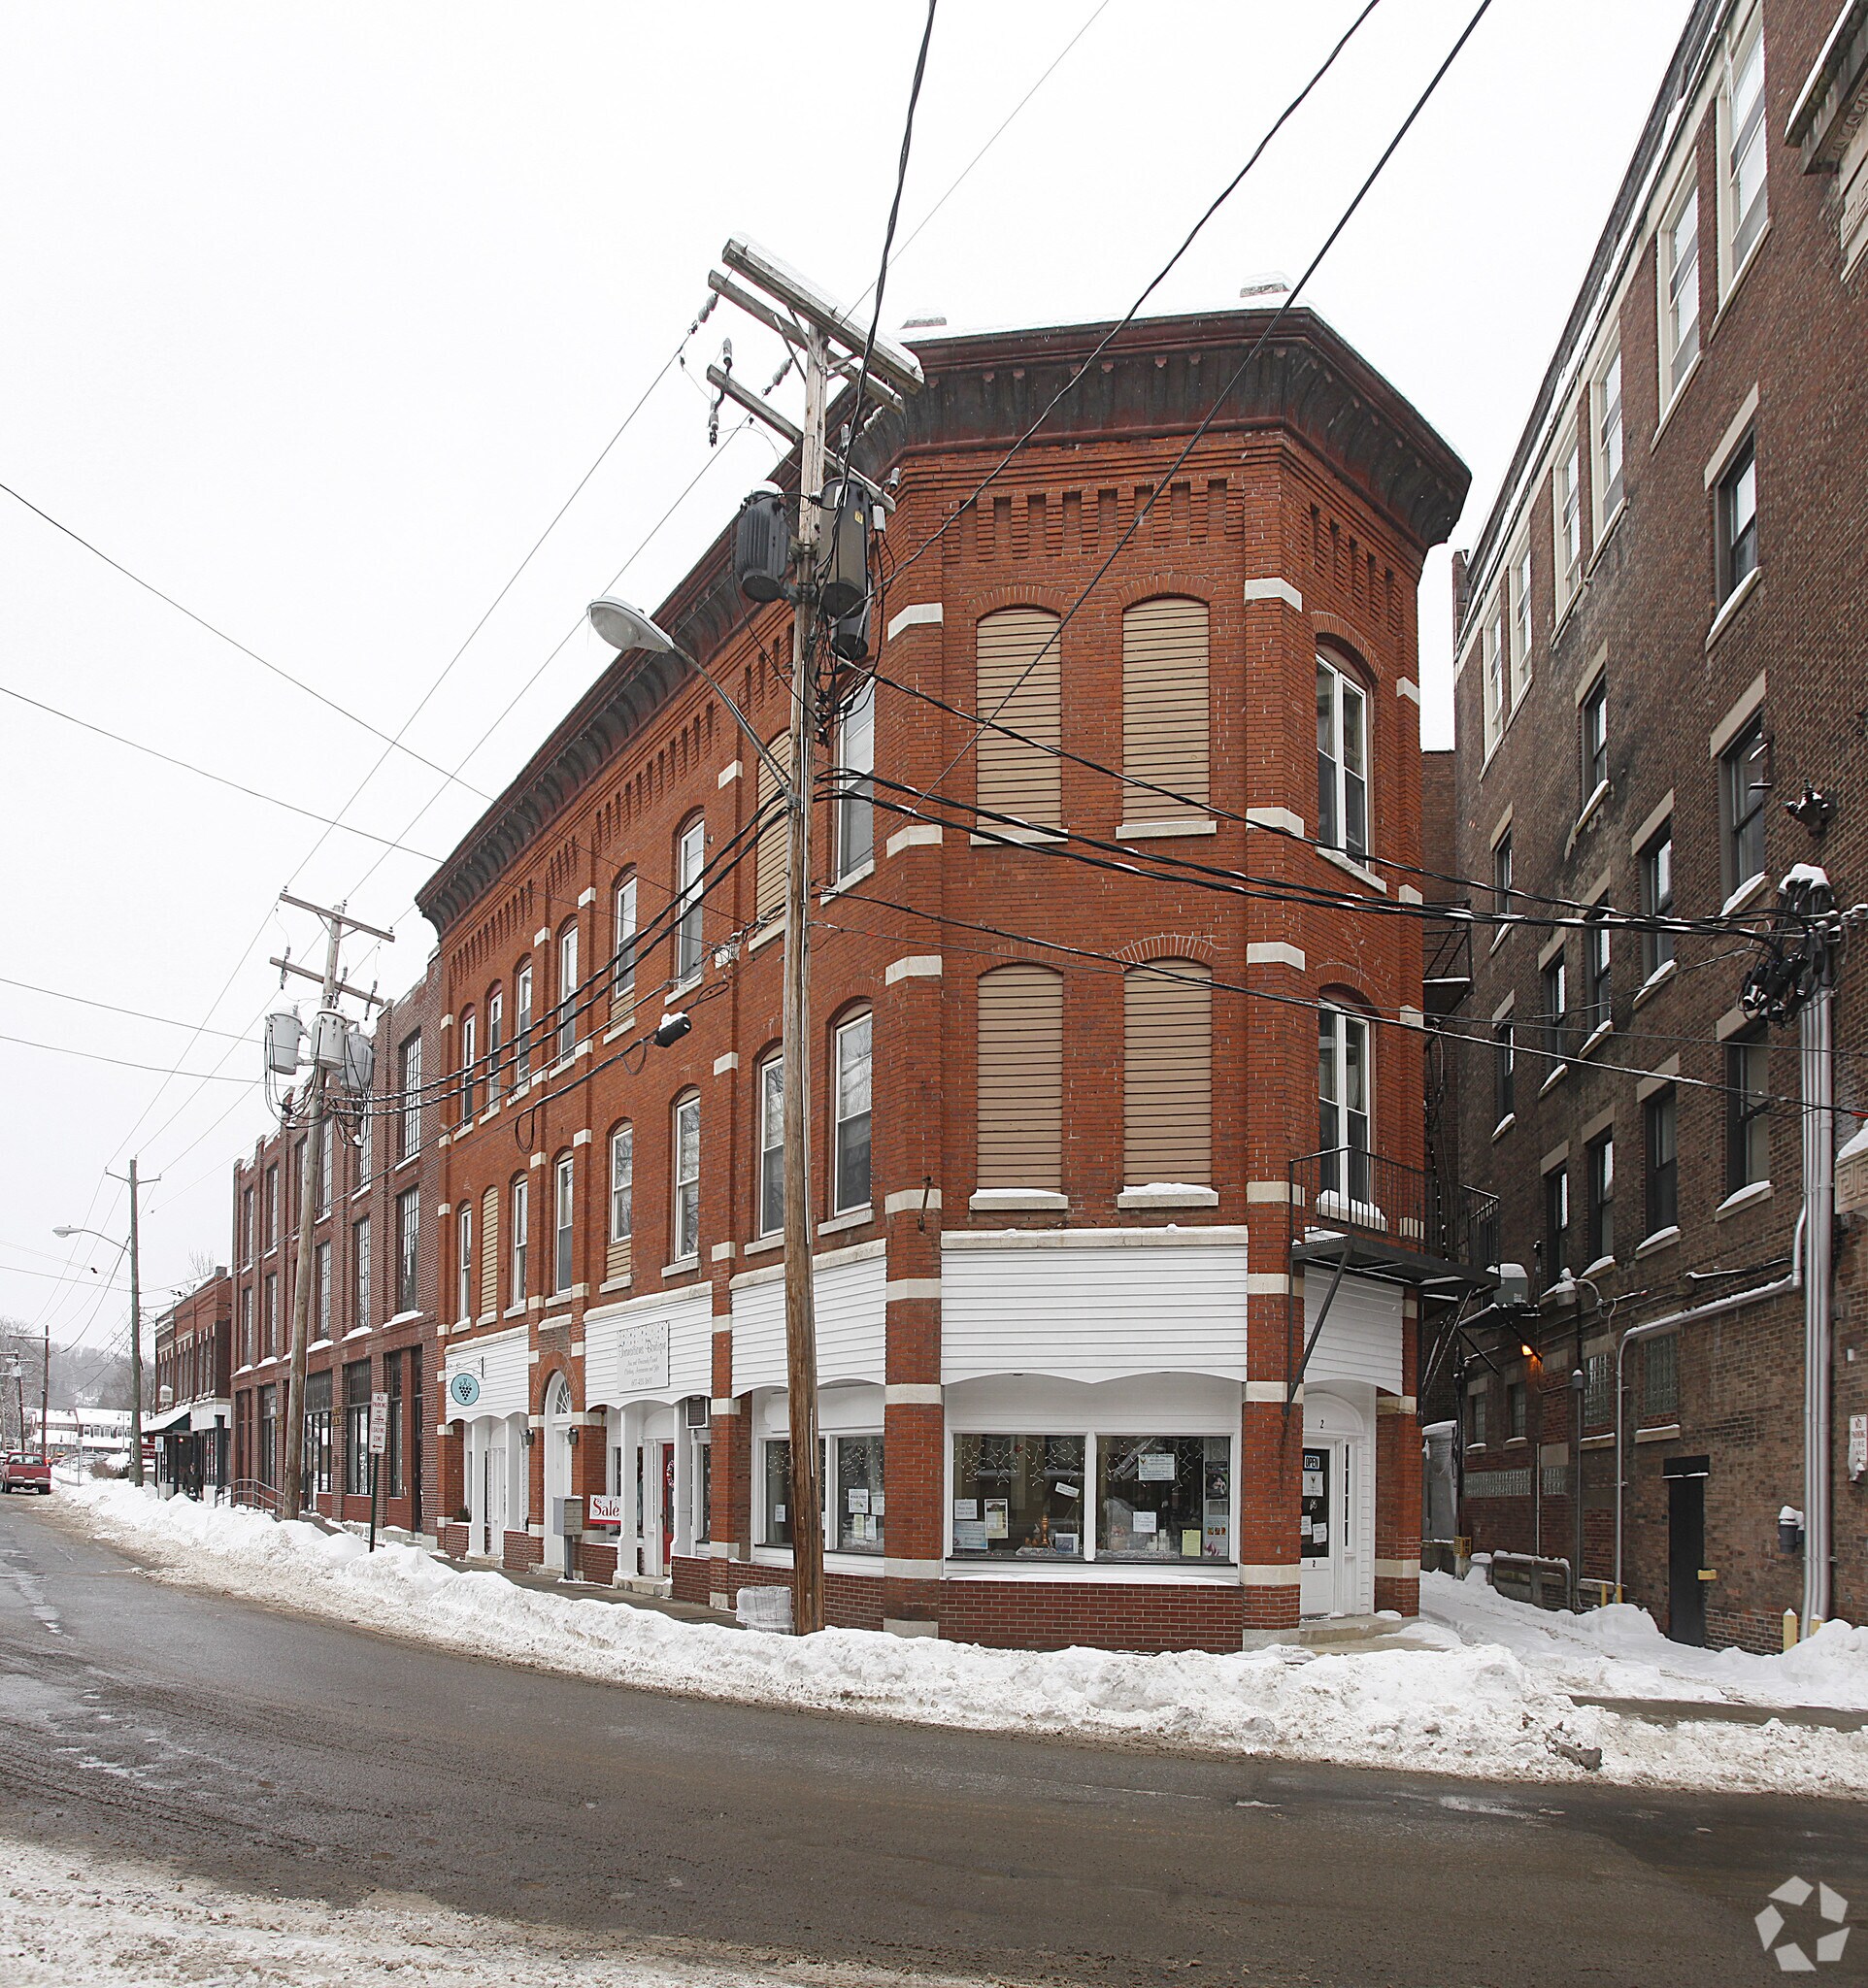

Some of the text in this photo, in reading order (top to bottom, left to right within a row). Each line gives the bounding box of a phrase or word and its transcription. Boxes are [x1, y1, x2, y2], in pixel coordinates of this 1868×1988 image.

[1320, 1419, 1325, 1428] 2
[1306, 1457, 1318, 1468] OPEN
[593, 1498, 619, 1516] Sale
[1312, 1559, 1317, 1568] 2
